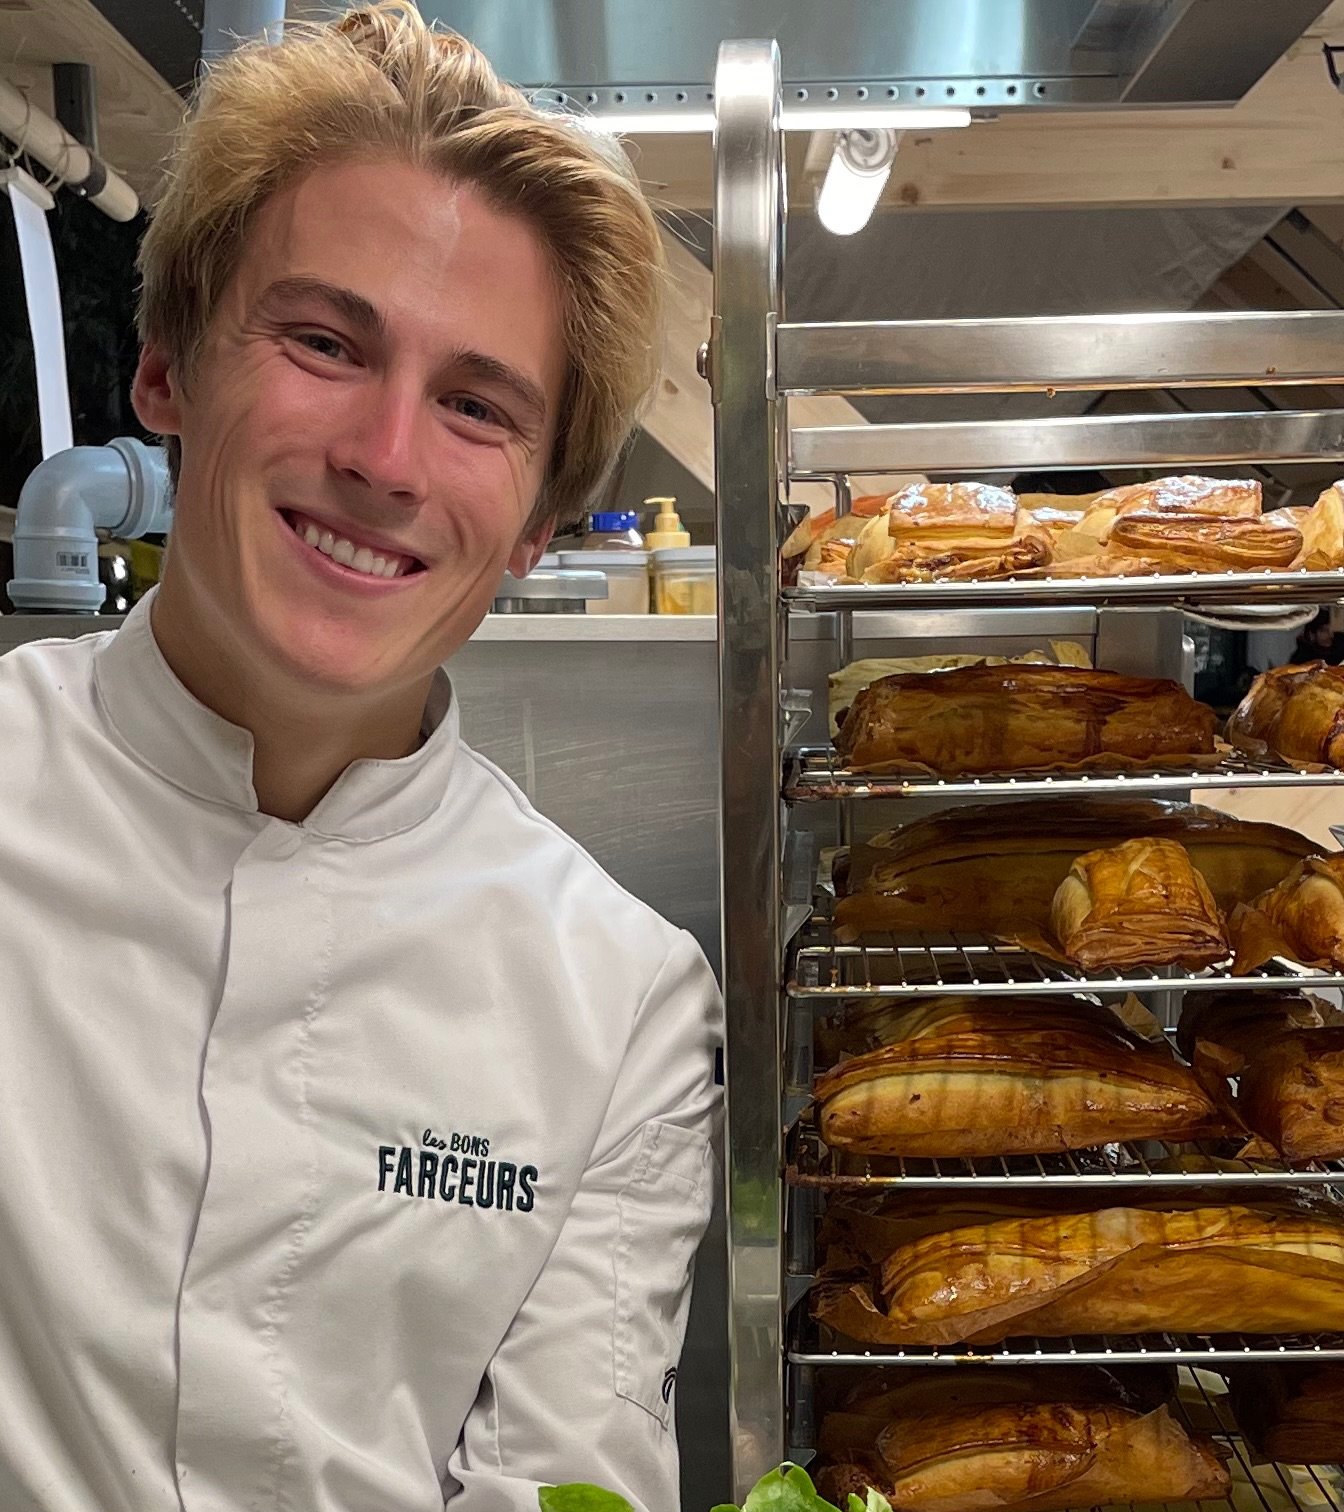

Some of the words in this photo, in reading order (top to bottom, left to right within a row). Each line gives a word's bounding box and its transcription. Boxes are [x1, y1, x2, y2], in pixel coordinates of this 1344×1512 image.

[422, 1128, 447, 1150] les
[450, 1132, 490, 1157] BONS
[378, 1145, 539, 1213] FARCEURS
